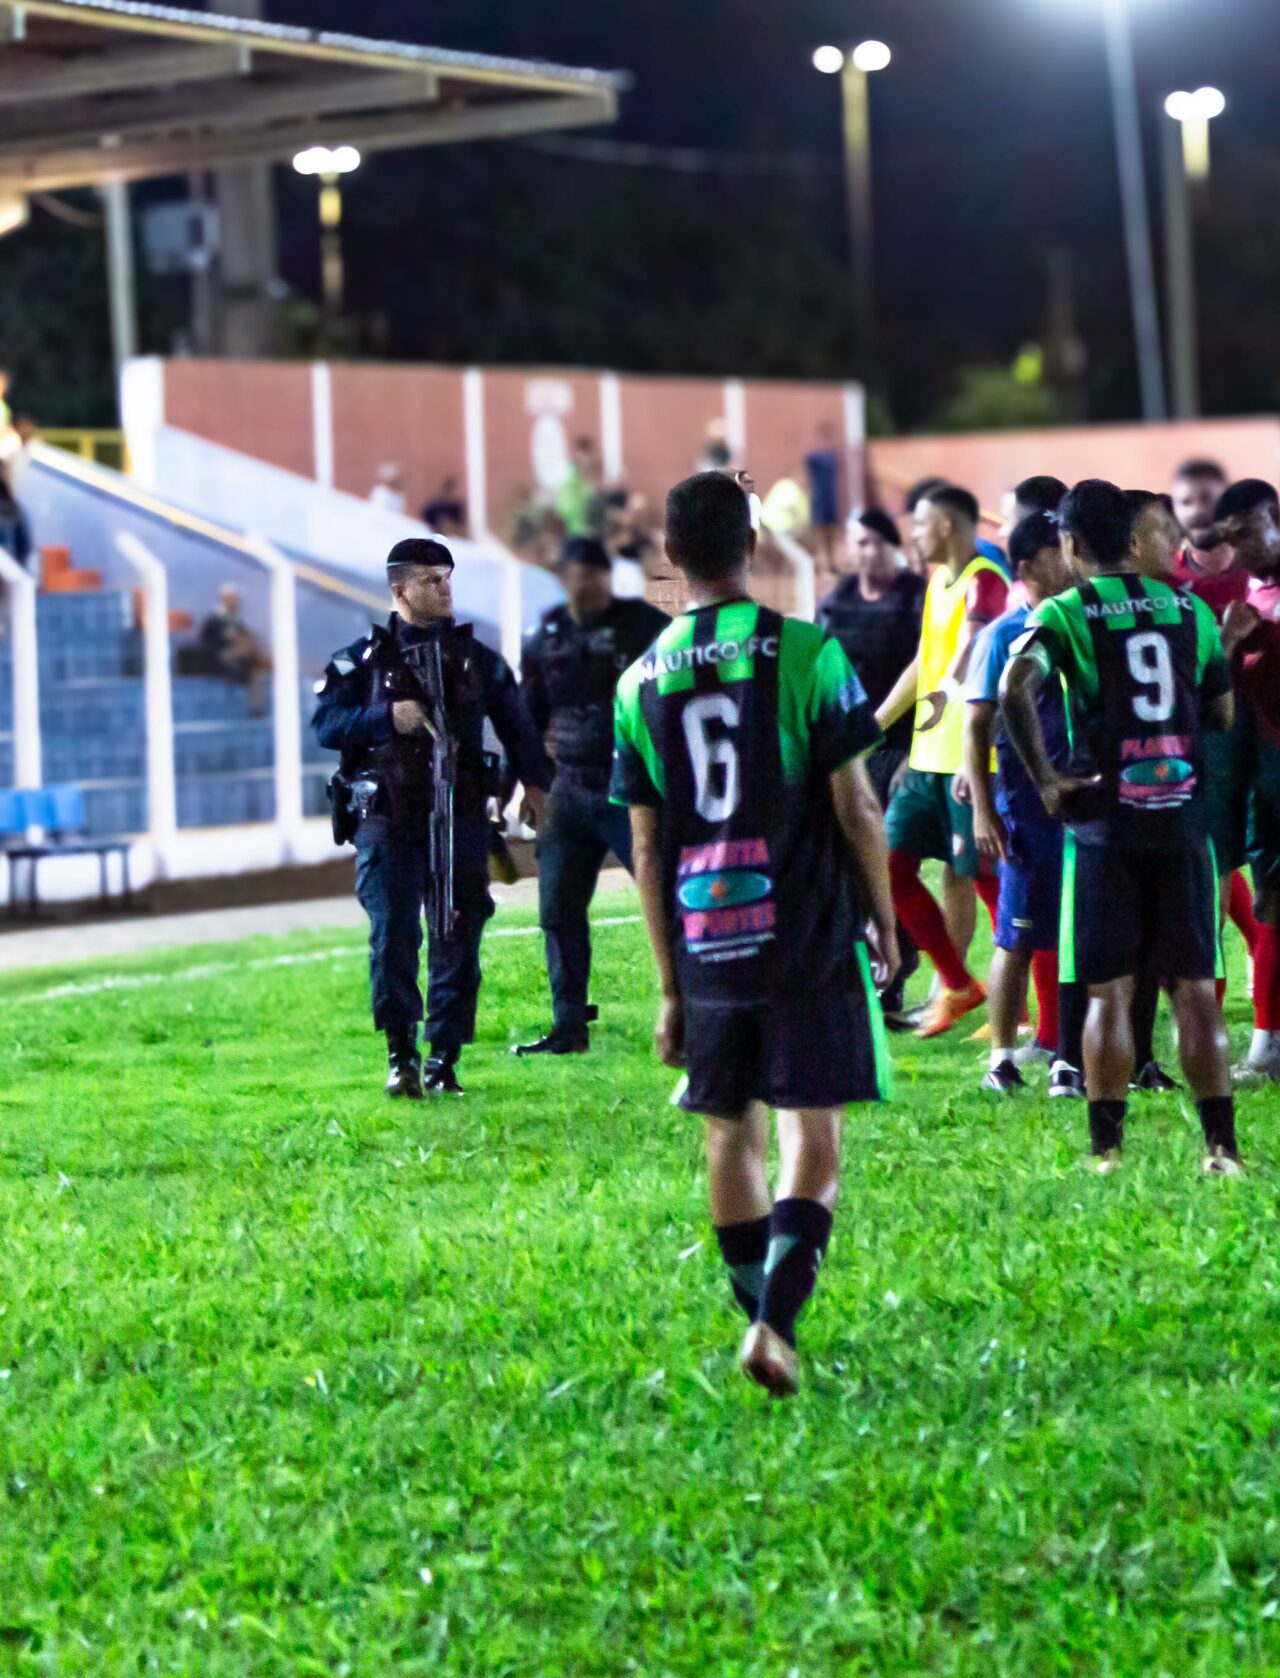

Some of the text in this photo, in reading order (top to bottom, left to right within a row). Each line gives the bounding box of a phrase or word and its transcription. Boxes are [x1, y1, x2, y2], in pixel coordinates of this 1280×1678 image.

[1084, 595, 1193, 618] NAUTICO FC
[639, 640, 739, 683] NAUTICO
[745, 635, 778, 658] FC
[1126, 631, 1174, 721] 9
[682, 694, 739, 822] 6
